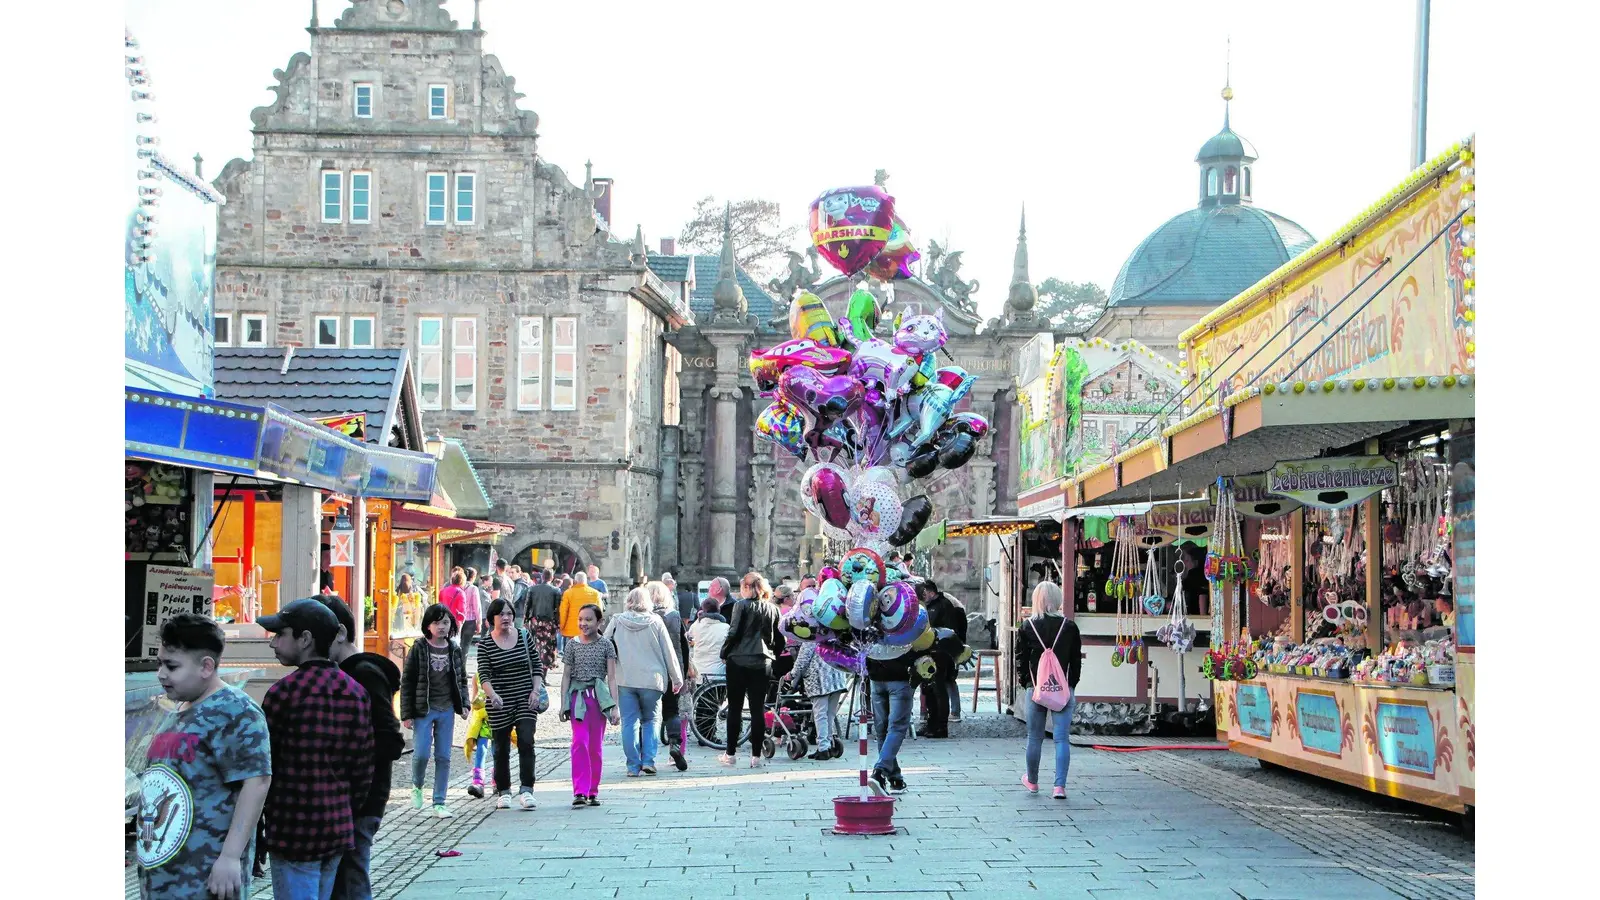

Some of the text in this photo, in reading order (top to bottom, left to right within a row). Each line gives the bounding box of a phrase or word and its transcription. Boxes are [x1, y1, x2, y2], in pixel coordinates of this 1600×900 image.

[816, 228, 875, 241] MARSHALL
[1272, 463, 1393, 491] Lebkuchenherze
[162, 594, 190, 604] Pfeile
